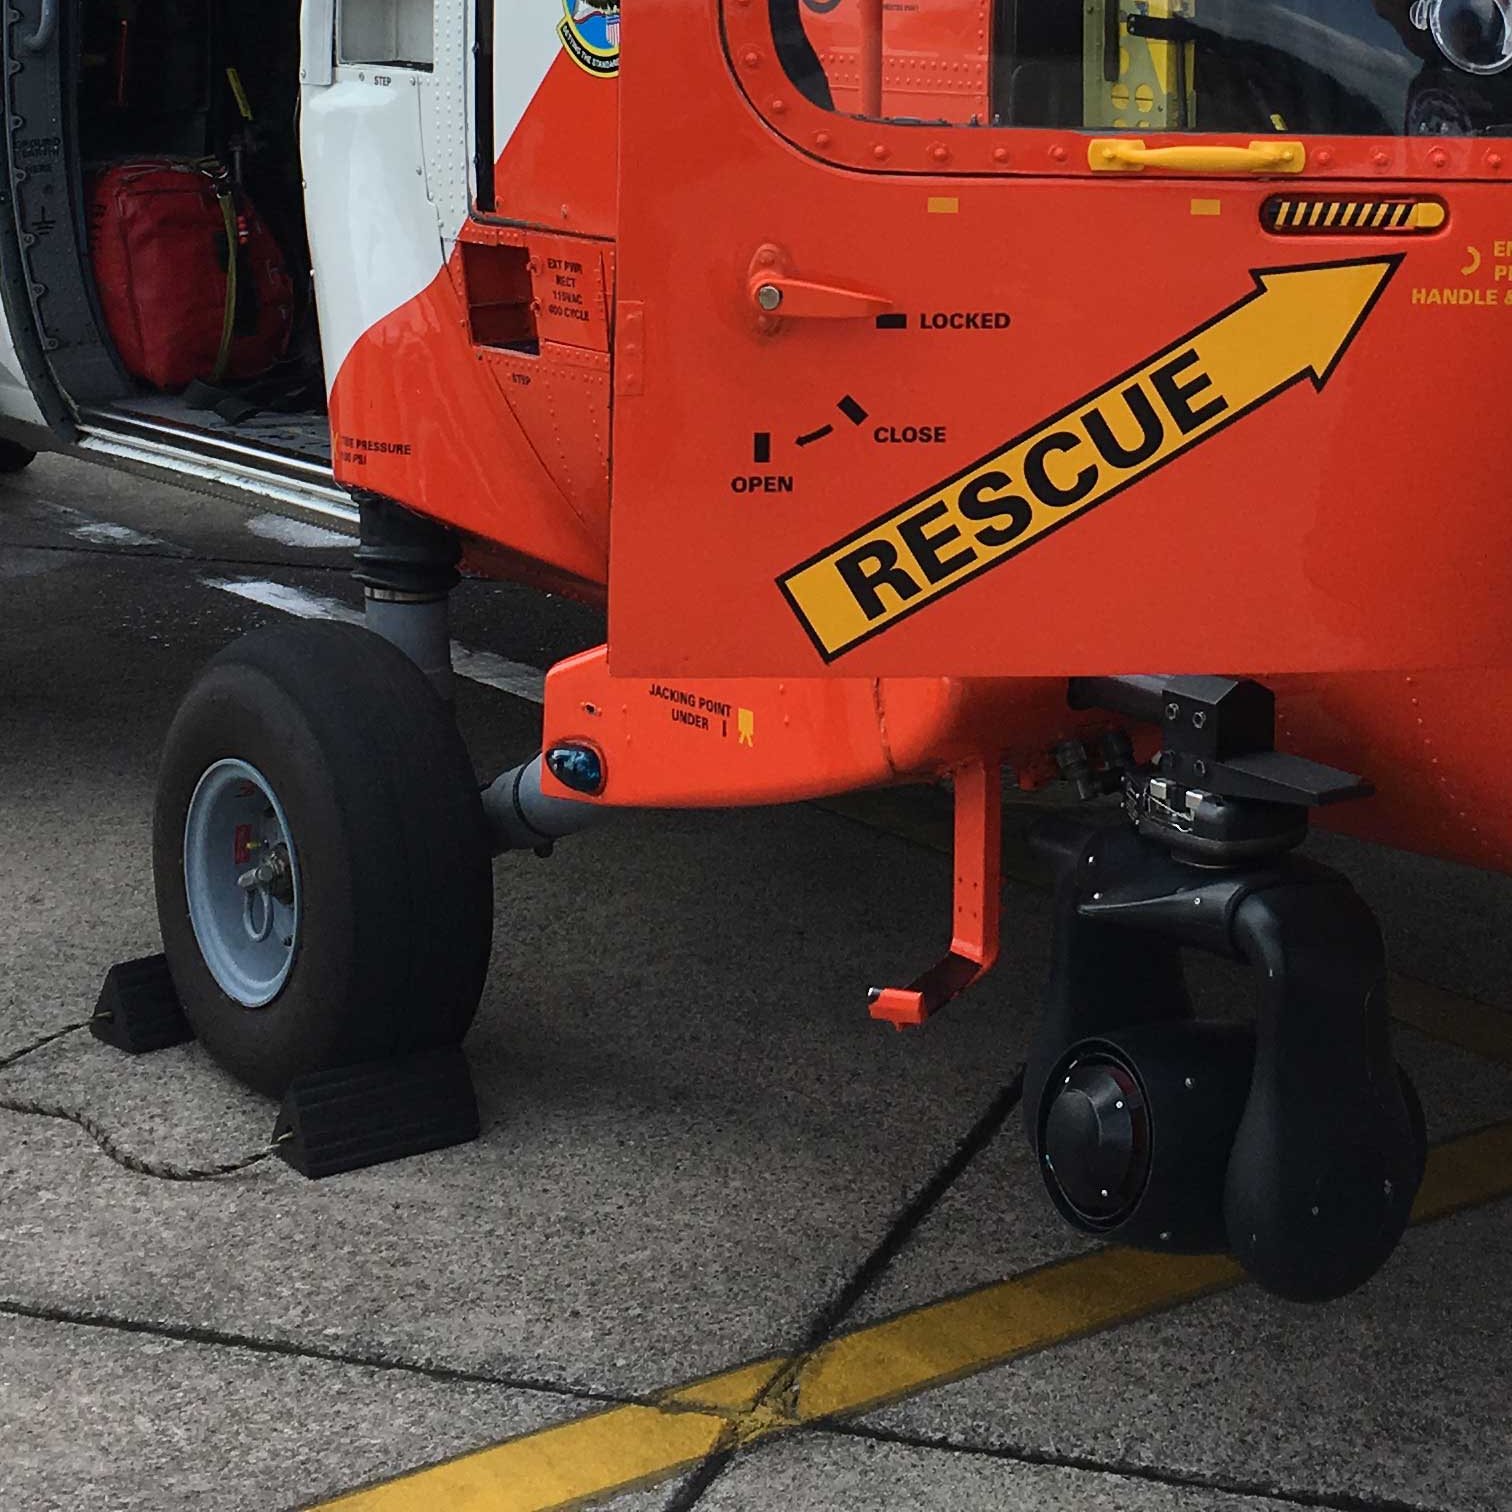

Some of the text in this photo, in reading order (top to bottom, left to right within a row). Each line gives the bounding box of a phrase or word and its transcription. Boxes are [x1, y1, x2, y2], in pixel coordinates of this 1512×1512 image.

[374, 75, 392, 87] STEP
[1411, 288, 1498, 306] HANDLE
[919, 312, 1011, 330] LOCKED
[873, 426, 947, 443] CLOSE
[356, 439, 412, 455] PRESSURE
[730, 475, 794, 493] OPEN
[834, 347, 1229, 622] RESCUE
[649, 683, 732, 717] JACKING POINT
[671, 708, 709, 731] UNDER
